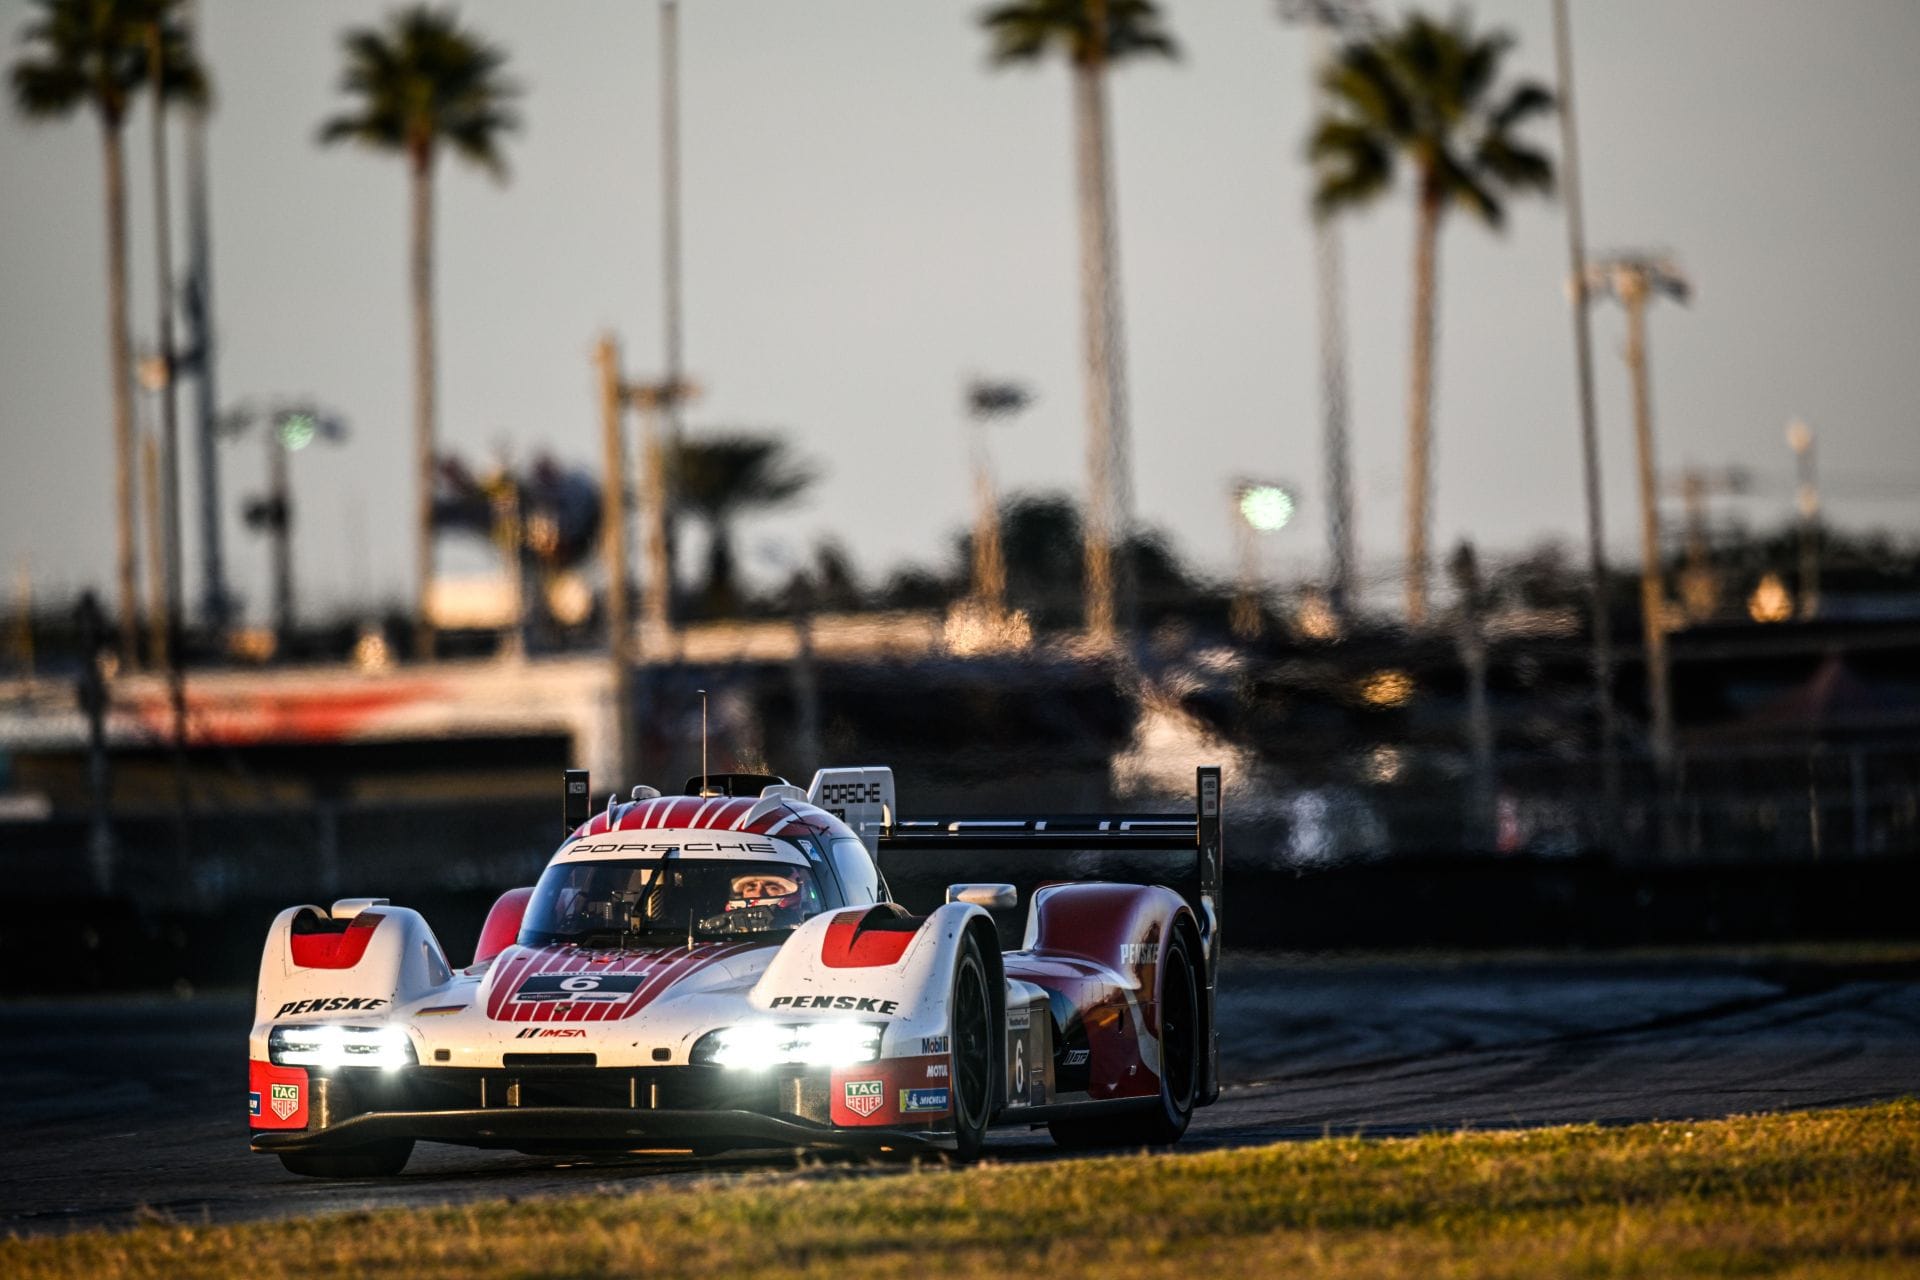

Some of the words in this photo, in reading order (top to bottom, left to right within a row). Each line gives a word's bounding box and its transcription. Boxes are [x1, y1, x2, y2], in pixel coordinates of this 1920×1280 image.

[822, 783, 881, 805] PORSCHE
[568, 843, 778, 856] PORSCHE
[560, 976, 603, 991] 6
[274, 997, 389, 1019] PENSKE
[769, 996, 899, 1015] PENSKE
[539, 1029, 587, 1038] IMSA
[926, 1065, 948, 1078] MOTUL
[1015, 1039, 1024, 1094] 6
[273, 1087, 296, 1099] TAG
[848, 1083, 880, 1095] TAG
[848, 1096, 881, 1114] HEUER
